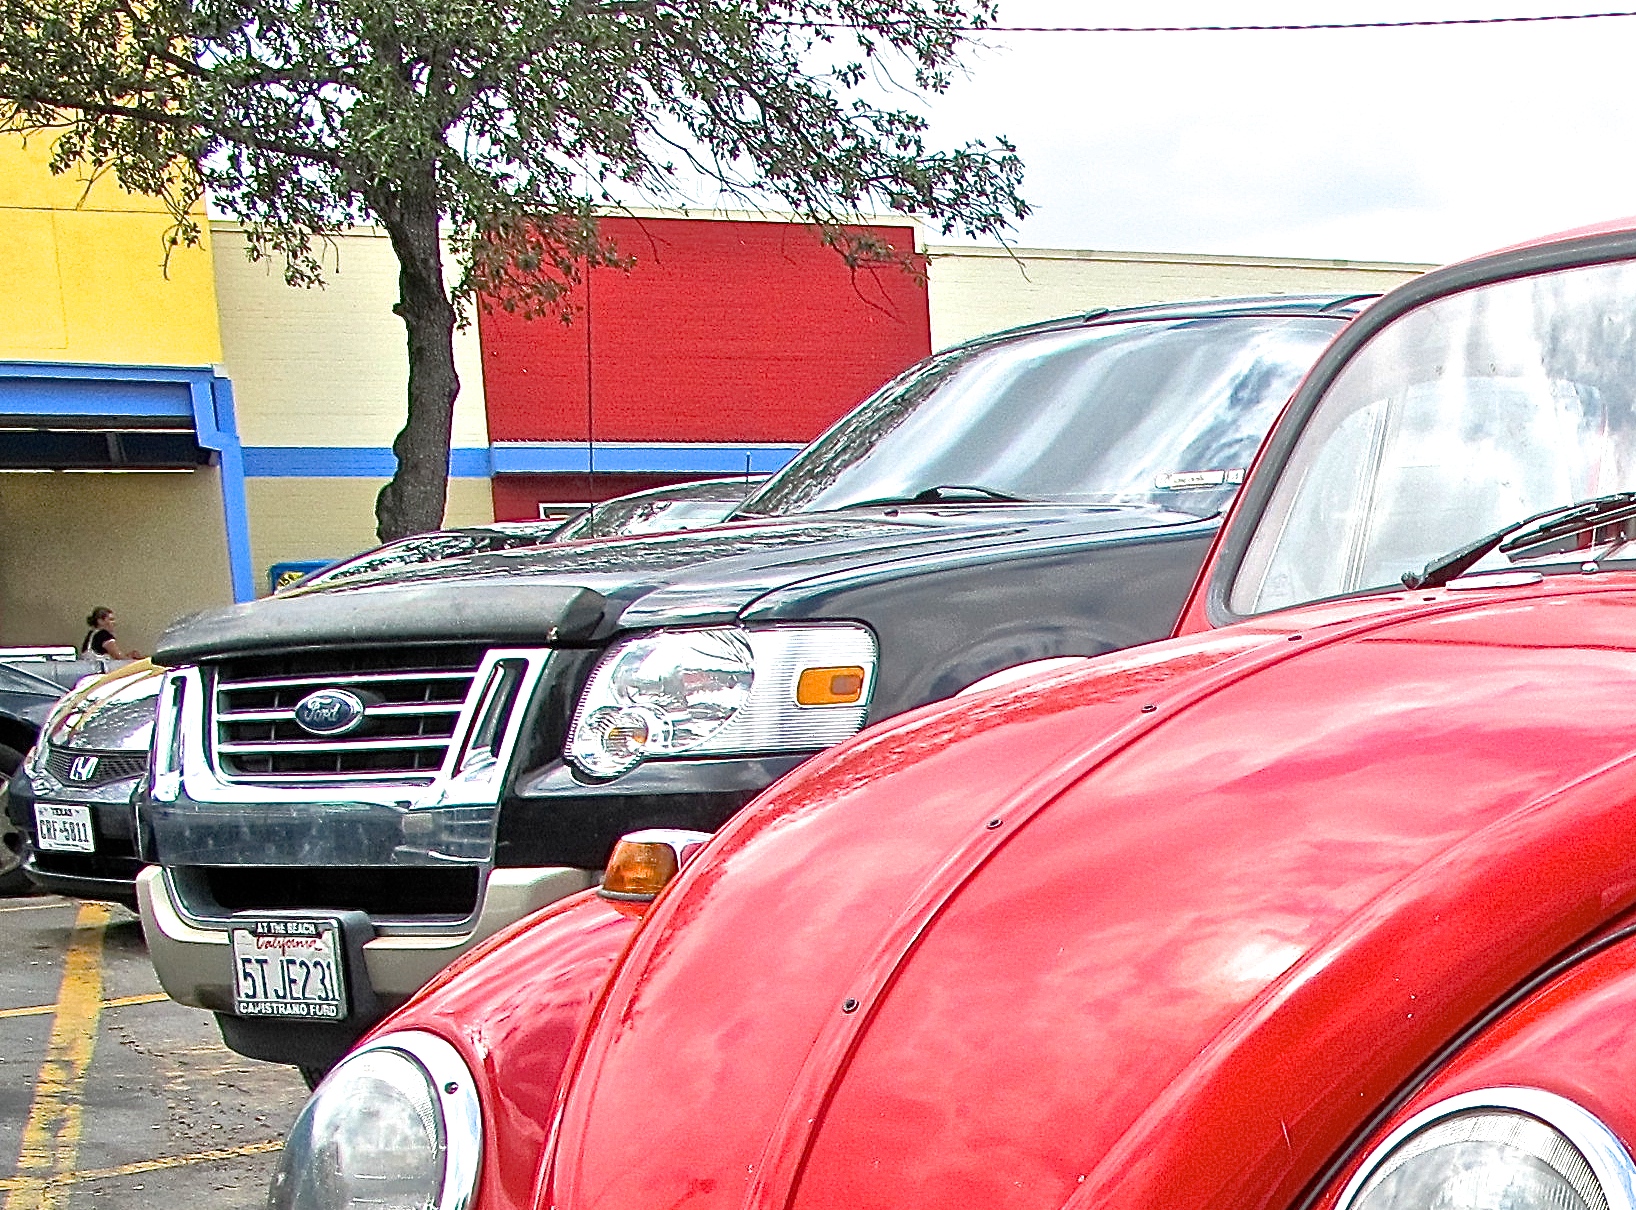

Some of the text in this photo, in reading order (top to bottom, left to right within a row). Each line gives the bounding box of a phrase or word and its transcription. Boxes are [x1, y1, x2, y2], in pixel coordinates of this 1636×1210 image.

[304, 697, 341, 722] Ford
[256, 922, 316, 935] AT THE BEACH
[256, 936, 323, 957] California
[240, 1002, 337, 1017] CAPISTRANO FORD
